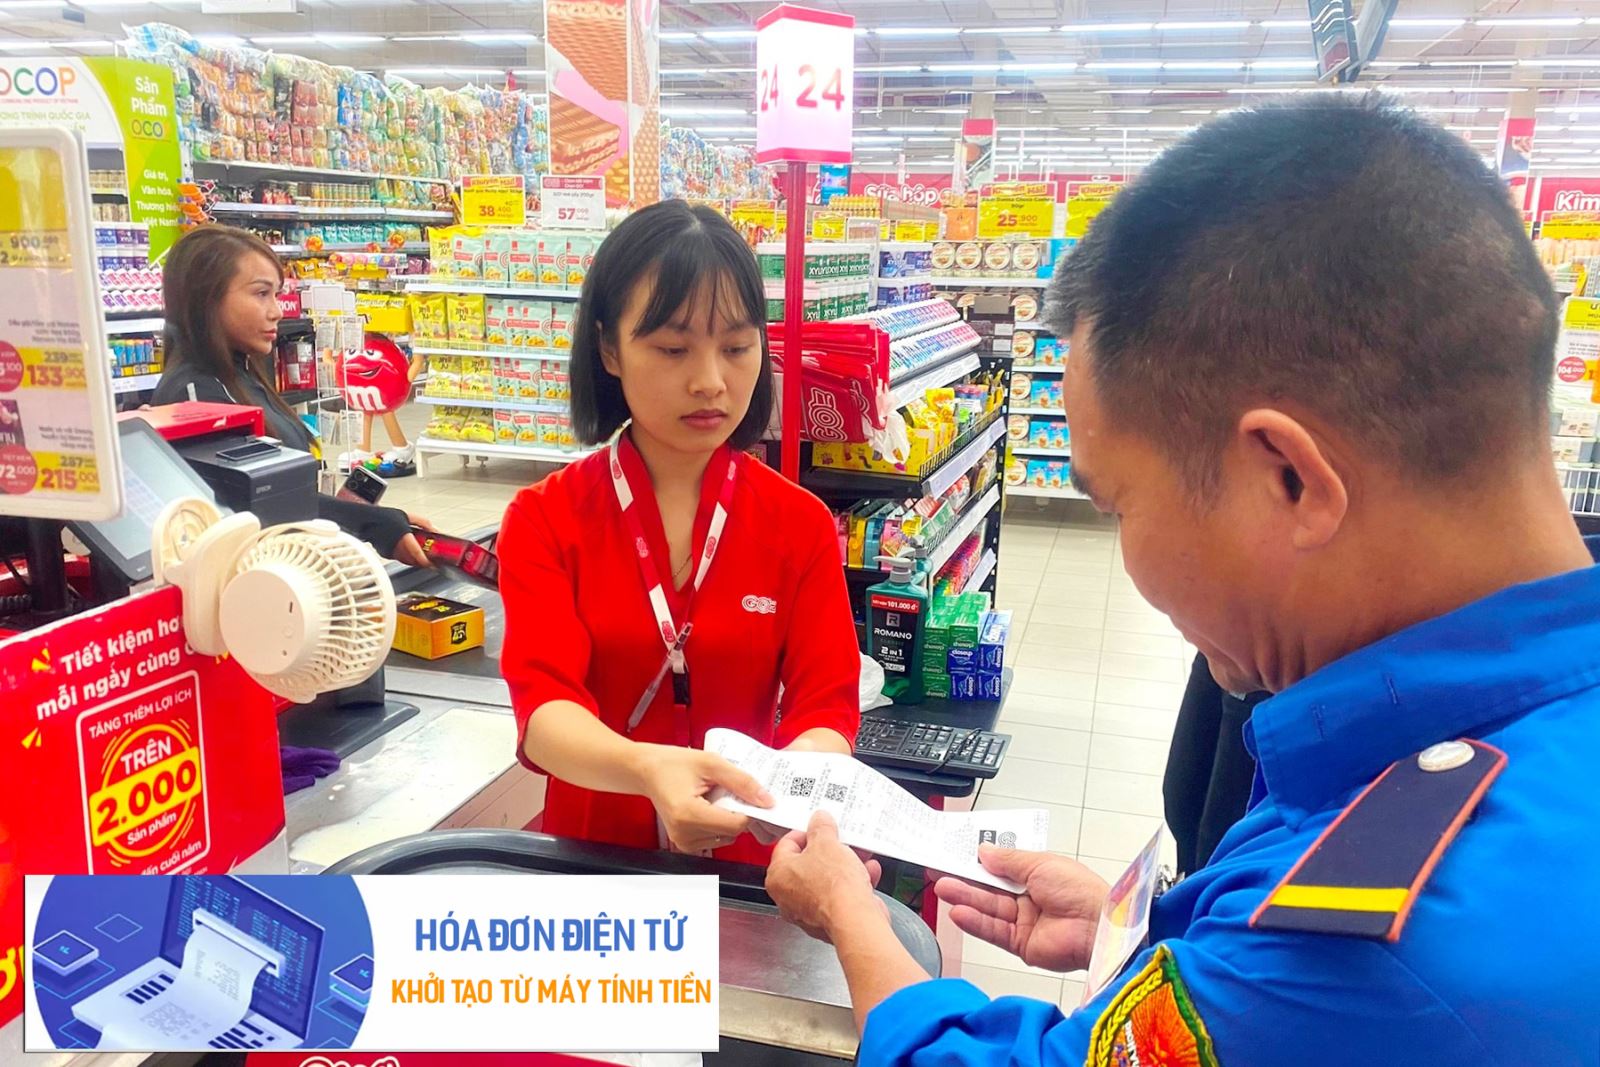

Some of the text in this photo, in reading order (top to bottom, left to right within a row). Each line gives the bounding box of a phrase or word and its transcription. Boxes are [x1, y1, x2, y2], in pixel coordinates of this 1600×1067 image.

[134, 76, 160, 95] Sản
[761, 64, 778, 111] 24
[796, 64, 845, 111] 24
[131, 96, 167, 117] Phẩm
[61, 641, 103, 675] Tiết
[107, 626, 154, 657] kiệm
[874, 627, 912, 640] ROMANO
[37, 684, 77, 720] mỗi
[137, 647, 181, 677] cùng
[123, 704, 154, 725] THÊM
[120, 736, 172, 775] TRÊN
[96, 759, 197, 837] 2.000
[127, 811, 178, 846] Sản phẩm
[160, 850, 180, 871] cuối
[181, 839, 202, 862] năm
